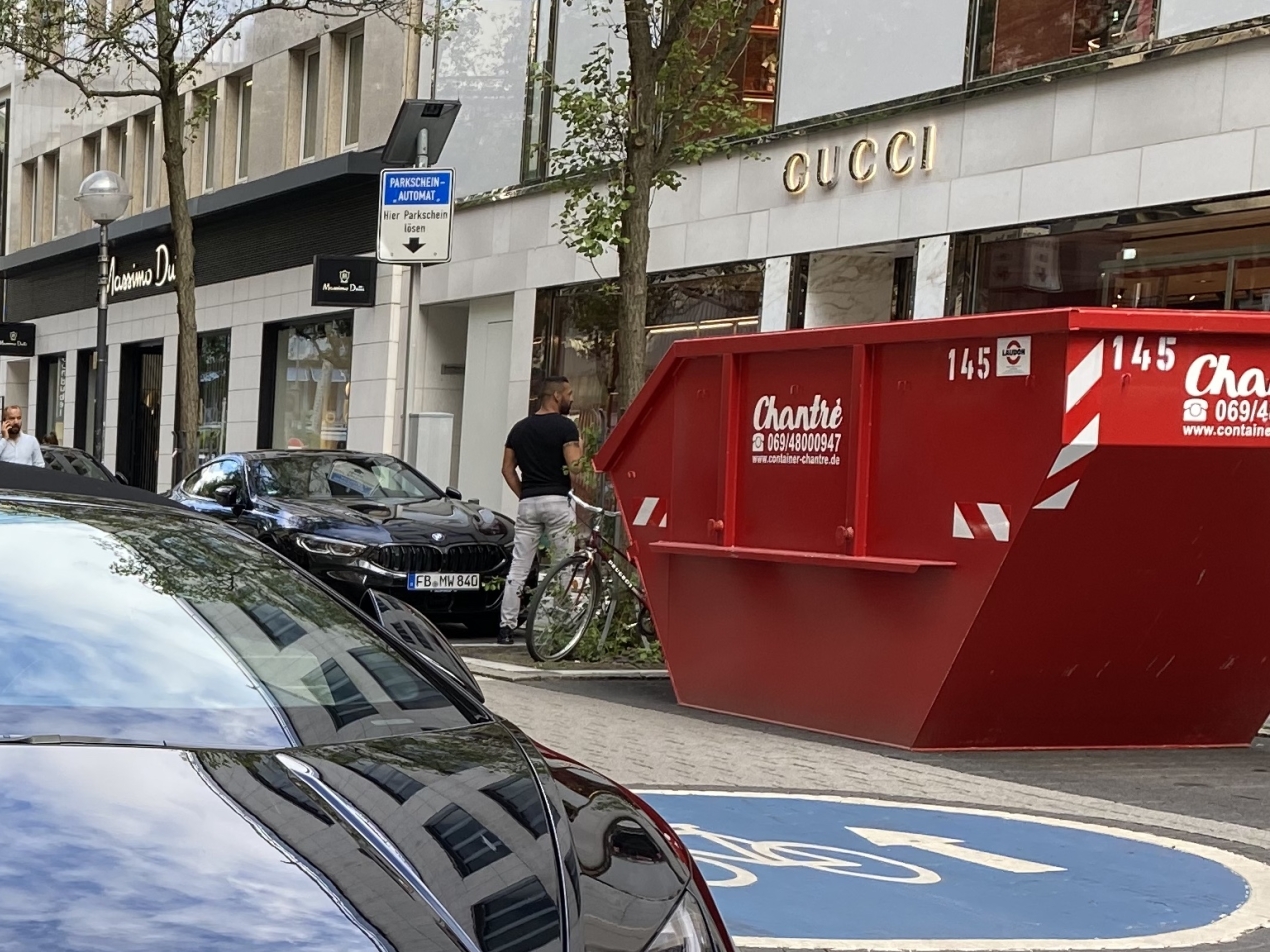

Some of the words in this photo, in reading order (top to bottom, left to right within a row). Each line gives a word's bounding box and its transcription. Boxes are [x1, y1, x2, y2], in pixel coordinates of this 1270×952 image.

[783, 125, 937, 195] GUCCI
[390, 177, 446, 188] PARKSCHEIN-
[398, 190, 436, 201] AUTOMAT
[383, 210, 400, 220] Hier
[404, 209, 448, 220] Parkschein
[404, 223, 426, 233] lösen
[155, 244, 177, 287] Du
[948, 346, 991, 381] 145
[1112, 335, 1177, 372] 145
[1185, 353, 1270, 398] Cha
[753, 394, 844, 432] Chantré
[1215, 399, 1270, 423] 069/4
[767, 432, 842, 452] 069/48000947
[752, 453, 841, 466] www.container-chantre.de
[416, 575, 432, 587] FB
[439, 575, 455, 587] MW
[457, 575, 478, 587] 840
